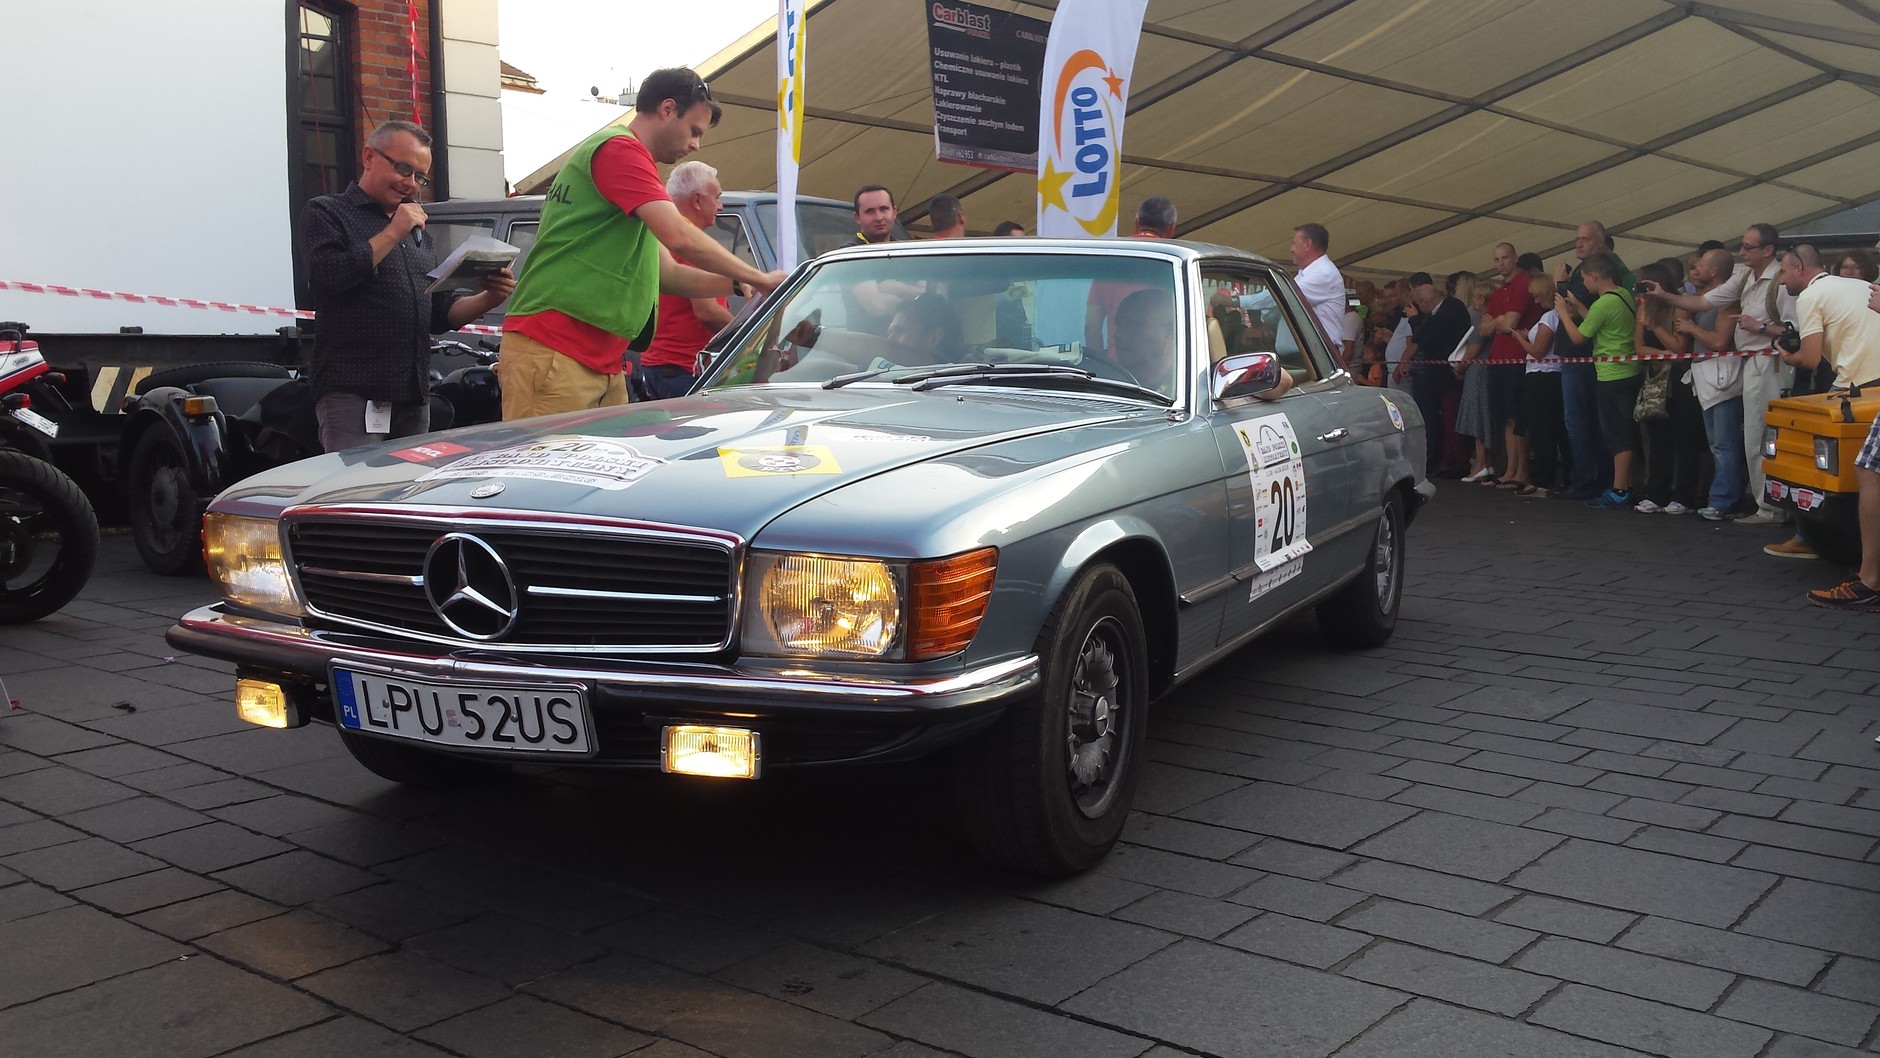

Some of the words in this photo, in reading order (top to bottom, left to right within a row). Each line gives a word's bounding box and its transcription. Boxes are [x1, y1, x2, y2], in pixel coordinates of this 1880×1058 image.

[933, 3, 990, 32] Carblast
[934, 48, 969, 61] Usuwanie
[971, 55, 993, 66] lakieru
[1000, 61, 1021, 71] plastik
[934, 61, 974, 74] Chemiczne
[975, 69, 1006, 80] usuwanie
[1006, 74, 1028, 85] lakieru
[935, 73, 949, 83] KTL
[935, 85, 966, 100] Naprawy
[968, 91, 1006, 105] blacharskie
[936, 98, 982, 112] Lakierowanie
[936, 111, 976, 124] Czyszczenie
[978, 119, 1003, 129] suchym
[1005, 122, 1024, 132] lodem
[937, 123, 967, 135] Transport
[1072, 86, 1108, 198] LOTTO
[550, 442, 597, 452] 20
[1271, 476, 1295, 554] 20
[344, 705, 357, 719] PL
[362, 680, 443, 736] LPU
[458, 693, 578, 745] 52US
